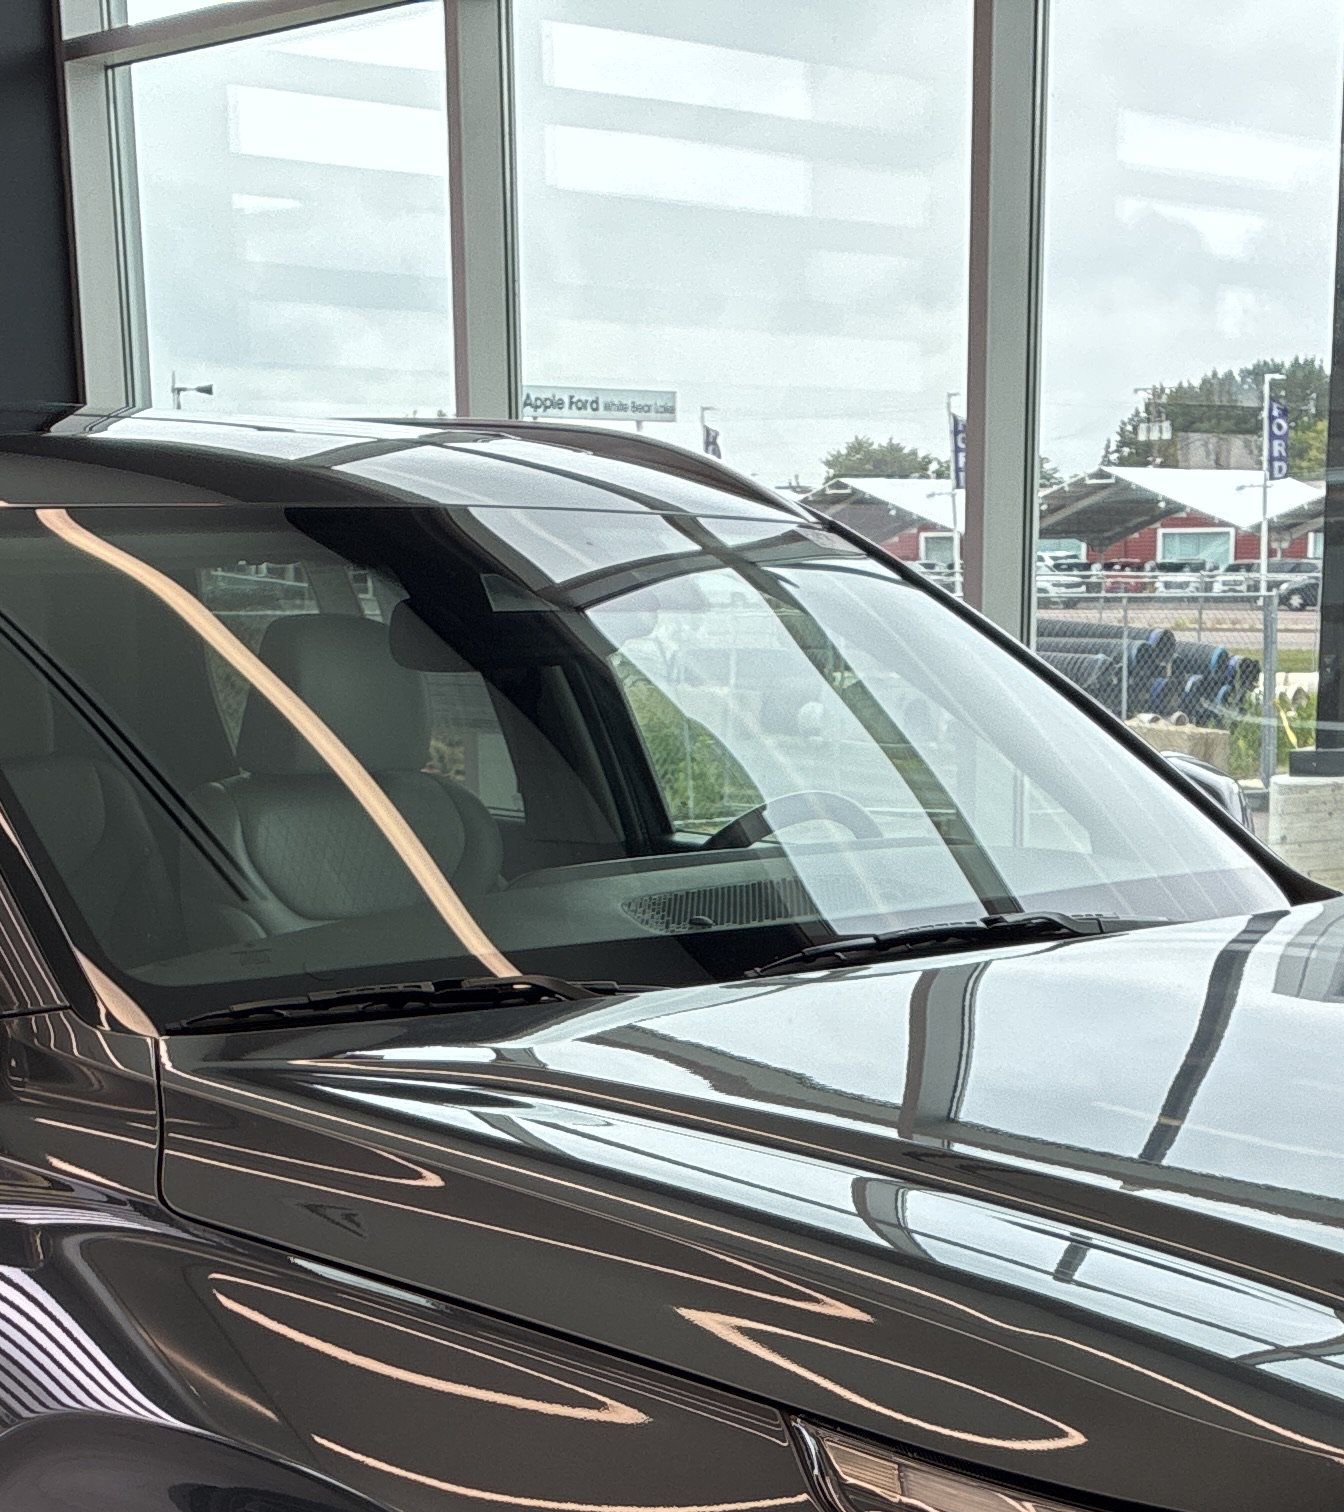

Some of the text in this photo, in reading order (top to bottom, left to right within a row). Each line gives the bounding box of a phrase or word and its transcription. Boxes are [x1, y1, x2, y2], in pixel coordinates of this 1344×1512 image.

[523, 393, 564, 412] Apple
[568, 395, 600, 411] Ford
[631, 401, 652, 414] Bear
[1271, 401, 1288, 478] FORD
